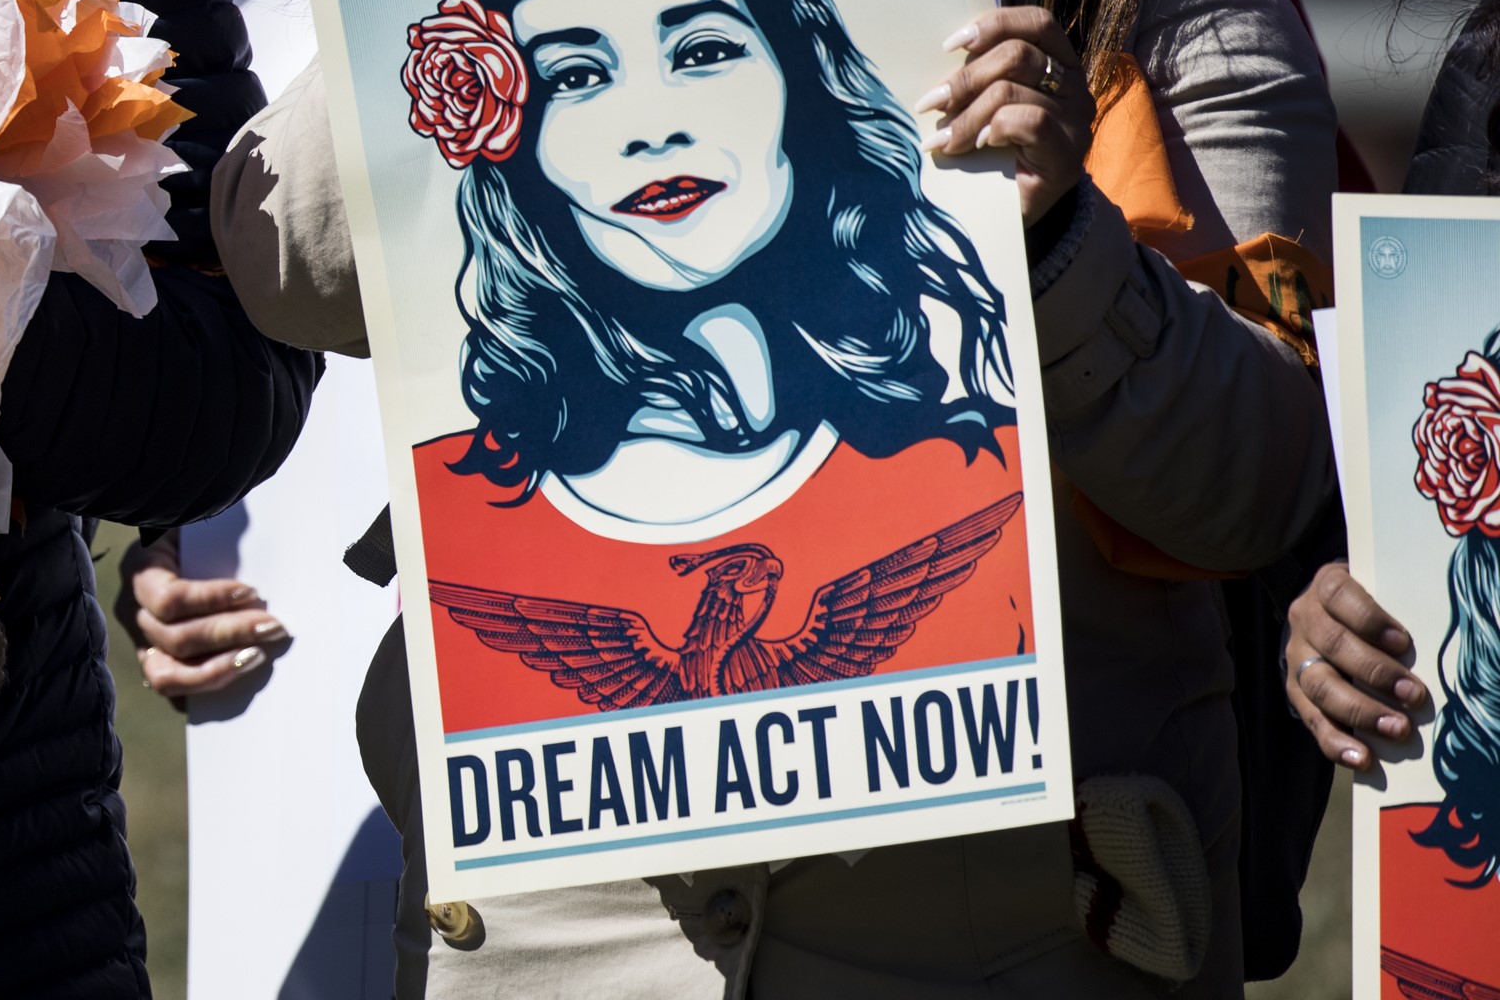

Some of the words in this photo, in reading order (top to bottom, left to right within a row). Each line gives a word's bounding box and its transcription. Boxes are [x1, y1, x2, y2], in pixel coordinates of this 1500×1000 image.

[446, 725, 691, 849] DREAM
[714, 704, 838, 814] ACT
[860, 676, 1043, 794] NOW!
